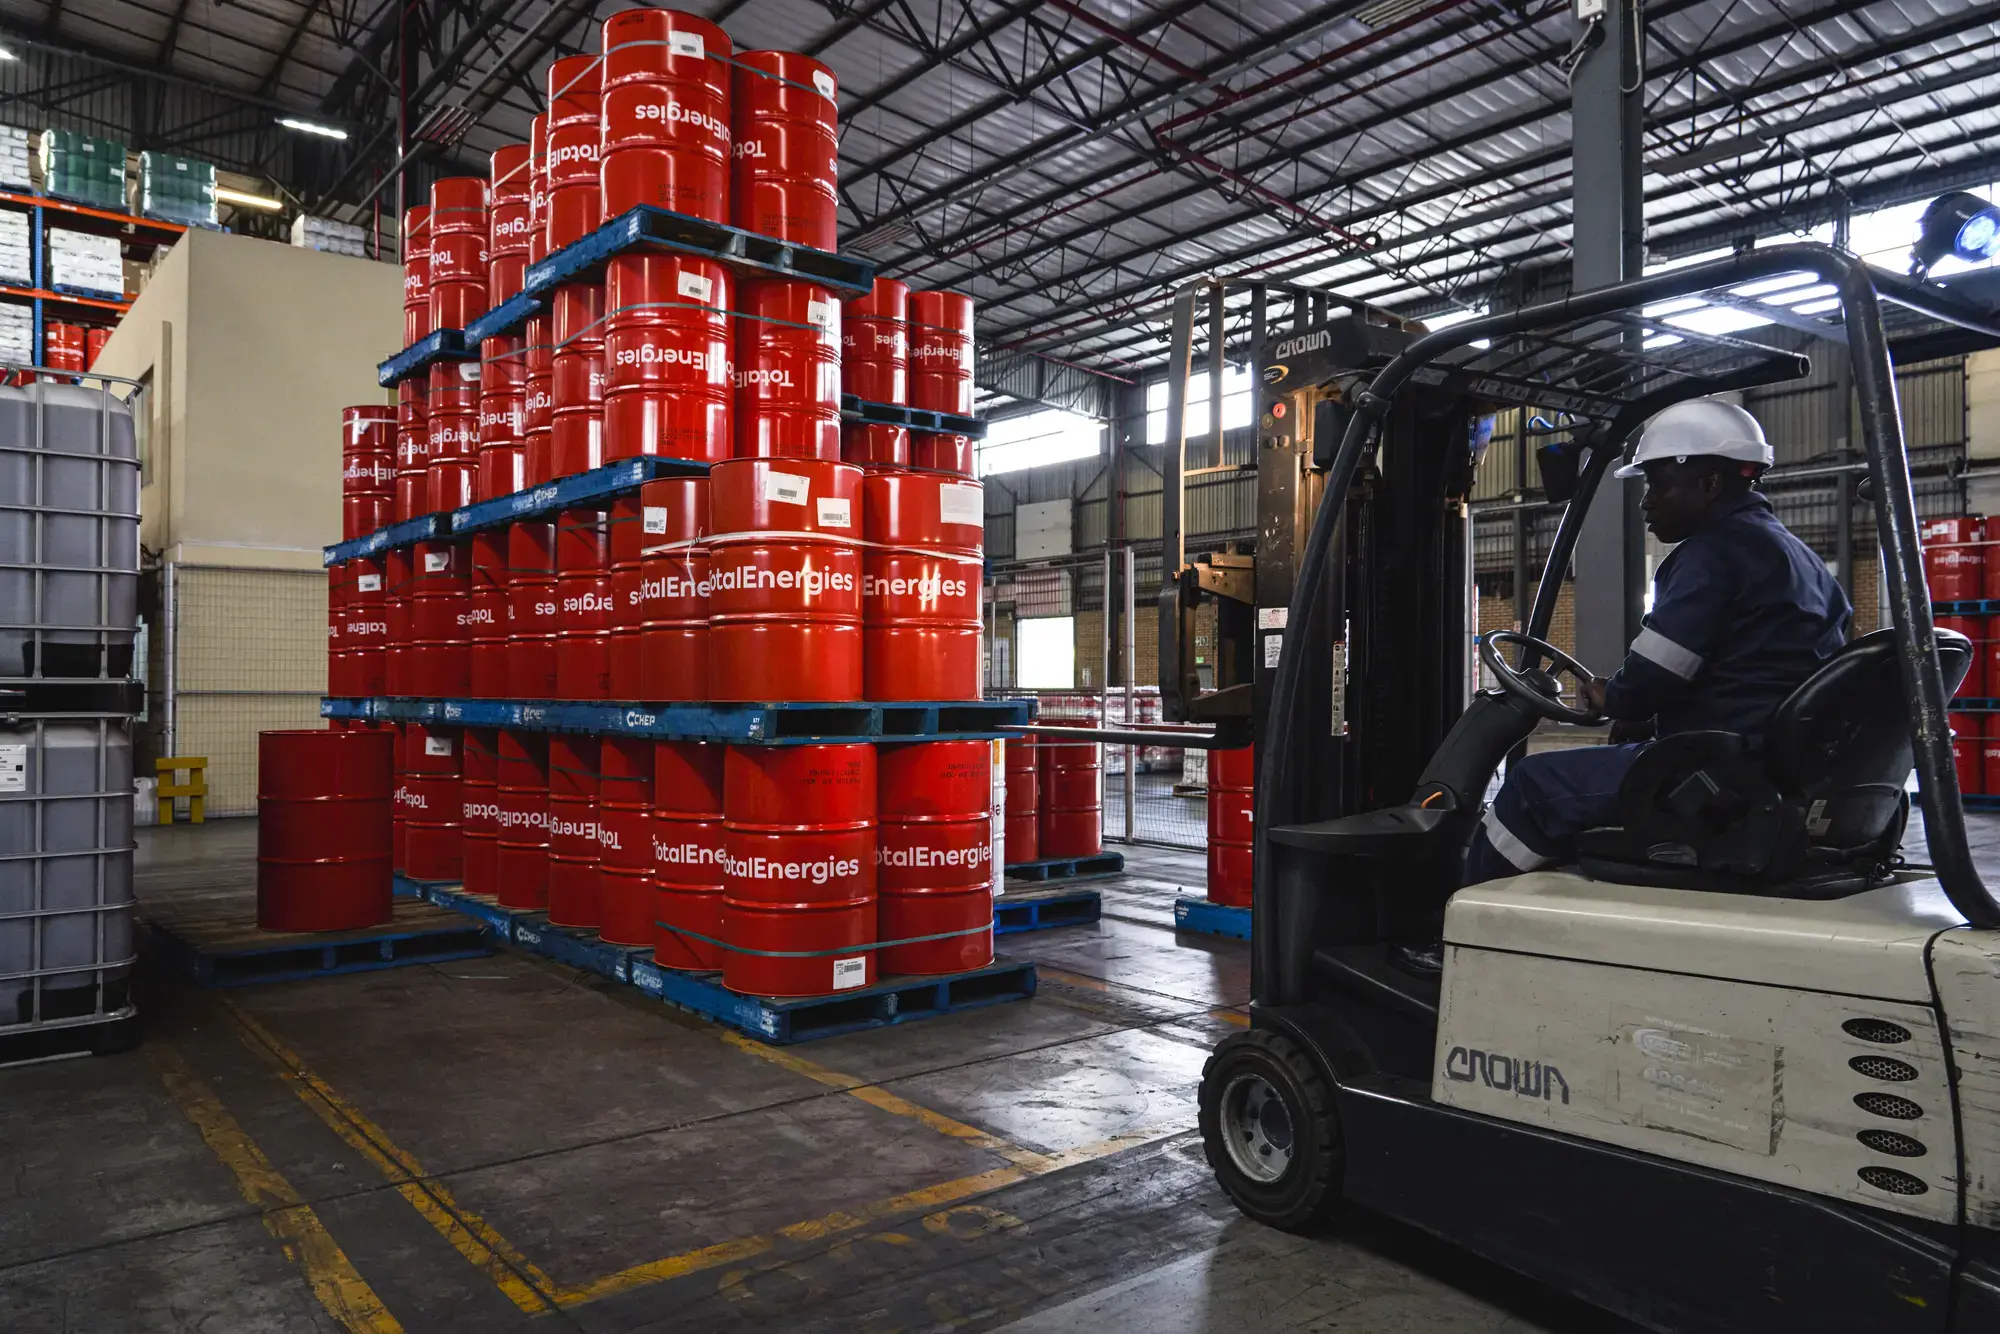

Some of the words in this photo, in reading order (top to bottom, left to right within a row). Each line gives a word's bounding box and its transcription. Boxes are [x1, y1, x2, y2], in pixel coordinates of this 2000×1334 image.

[1275, 329, 1332, 360] CROWN
[862, 573, 967, 602] Energies
[633, 712, 656, 727] CHEP
[724, 854, 859, 885] otalEnergies
[1446, 1045, 1570, 1105] CROWN
